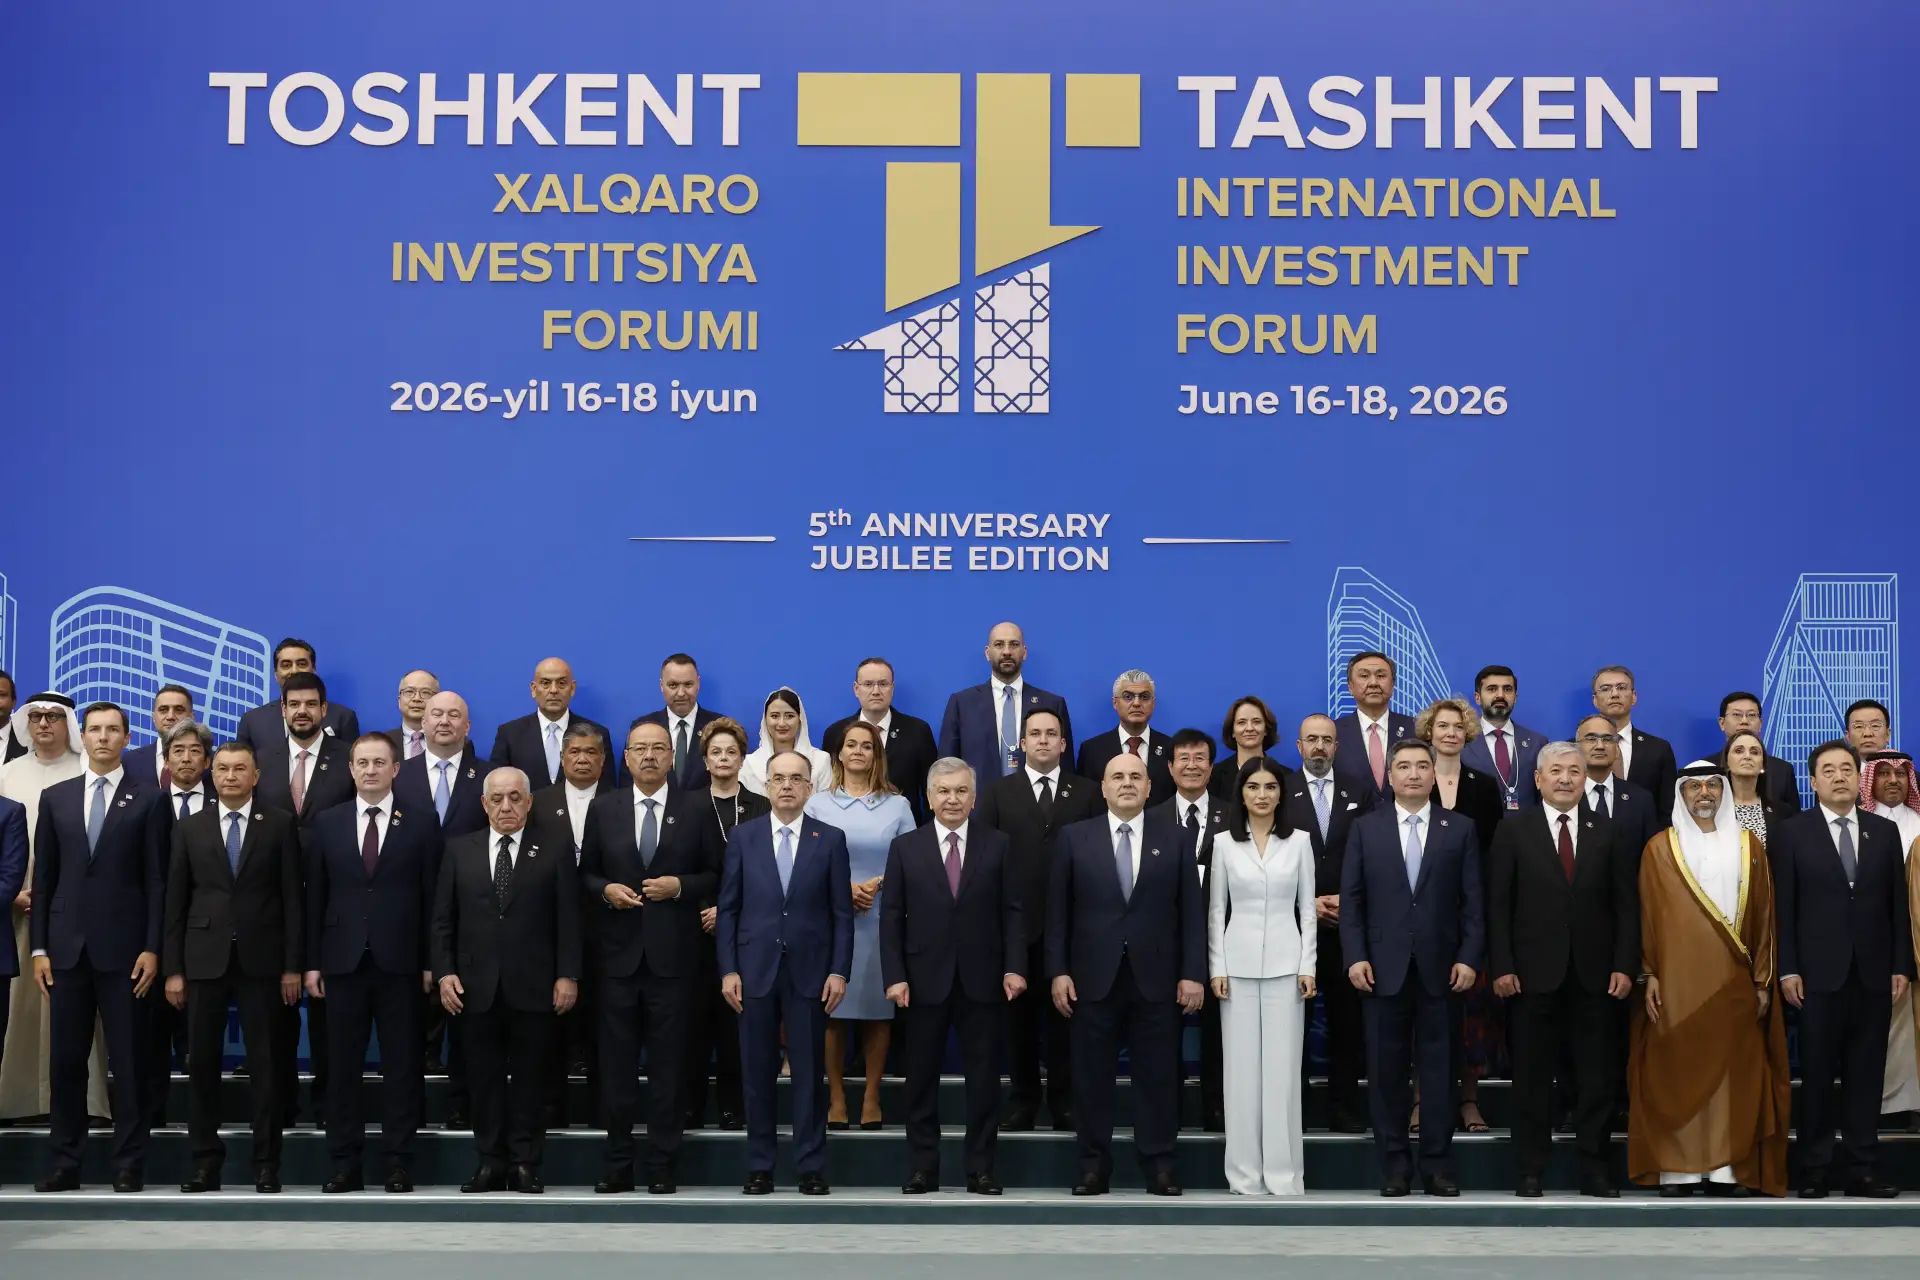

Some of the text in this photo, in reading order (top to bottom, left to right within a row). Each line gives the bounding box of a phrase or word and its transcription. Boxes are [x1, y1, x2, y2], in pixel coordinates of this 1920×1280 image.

[208, 71, 761, 147] TOSHKENT
[1177, 75, 1719, 151] TASHKENT
[492, 173, 760, 216] XALQARO
[1177, 177, 1618, 219] INTERNATIONAL
[391, 241, 758, 284] INVESTITSIYA
[1177, 245, 1529, 287] INVESTMENT
[542, 309, 759, 352] FORUMI
[1177, 313, 1378, 355] FORUM
[389, 379, 757, 420] 2026-yil 16-18 iyun
[1177, 384, 1508, 421] June 16-18, 2026
[808, 508, 1111, 538] 5th ANNIVERSARY
[810, 545, 1110, 571] JUBILEE EDITION
